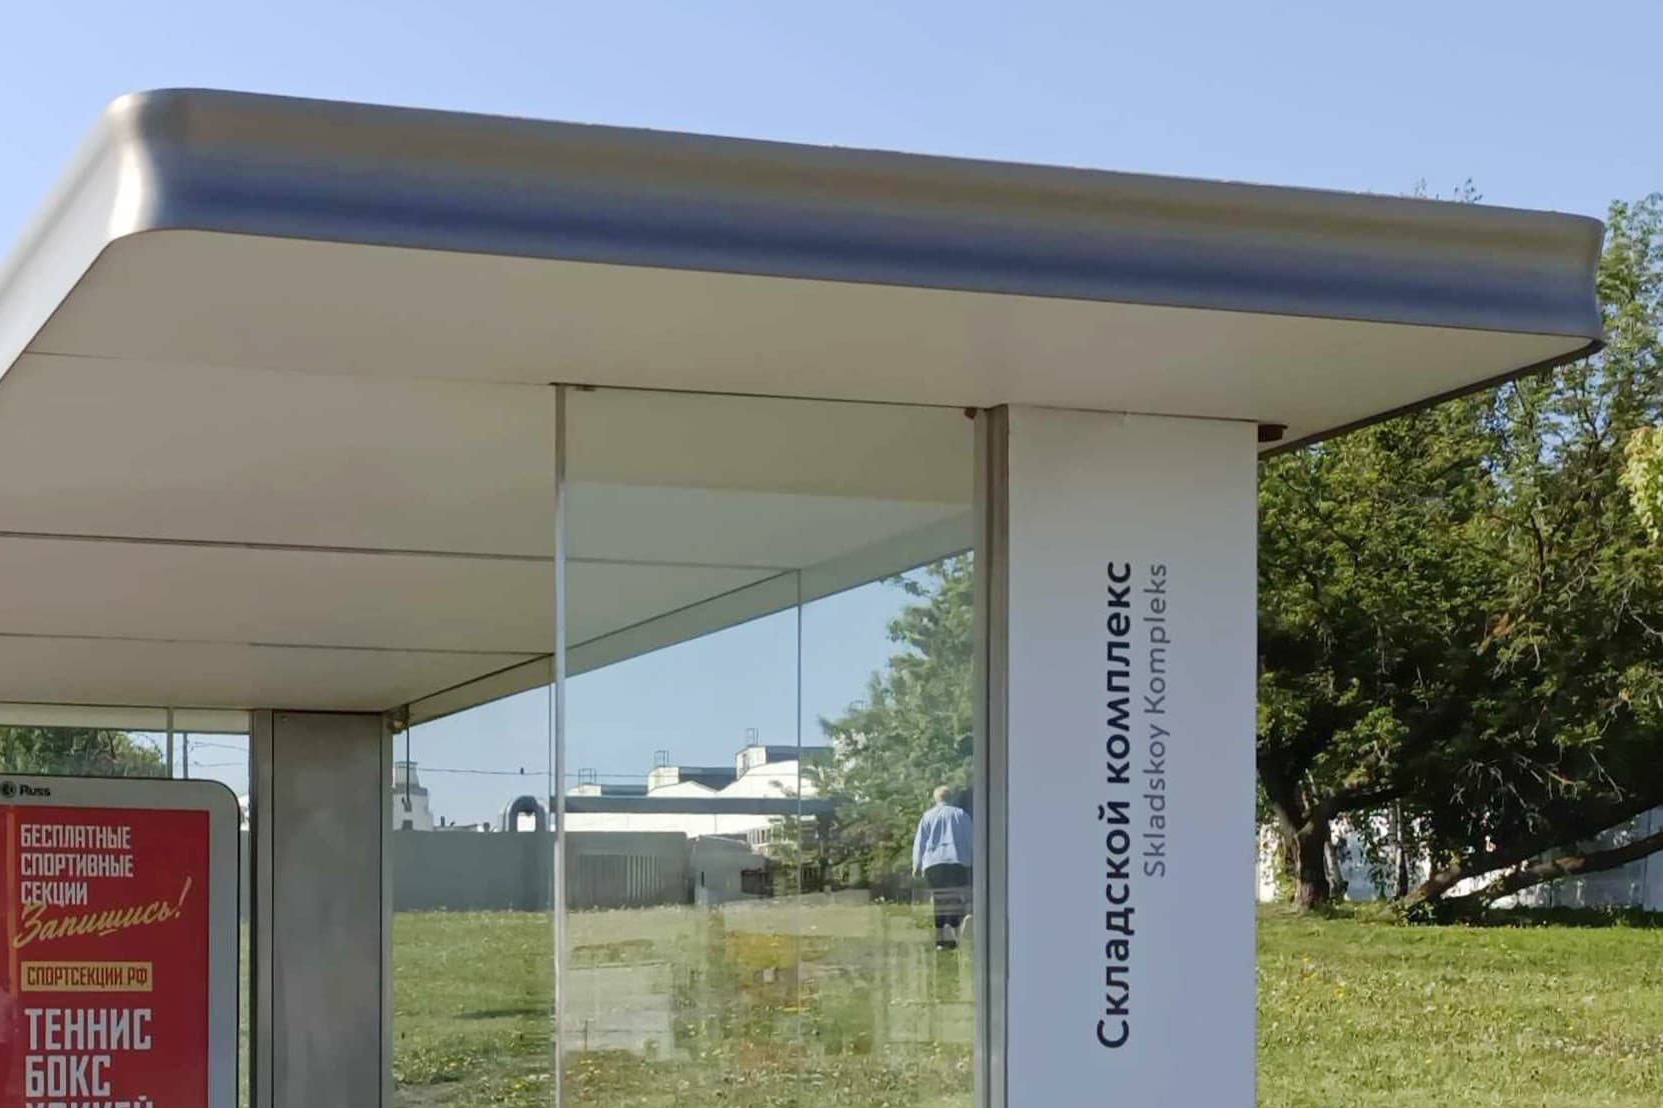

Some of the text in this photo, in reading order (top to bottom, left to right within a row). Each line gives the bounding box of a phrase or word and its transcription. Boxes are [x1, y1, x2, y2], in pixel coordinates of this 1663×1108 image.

[1143, 564, 1171, 878] Skladskoy Kompleks
[19, 784, 51, 797] Russ
[1096, 562, 1134, 1048] Складской комплекс
[21, 824, 131, 849] БЕСПЛАТНЫЕ
[21, 853, 134, 877] СПОРТИВНЫЕ
[13, 876, 193, 948] Запишись!
[21, 881, 88, 907] СЕКЦИИ
[24, 1008, 152, 1050] ТЕННИС
[25, 1055, 111, 1097] БОКС
